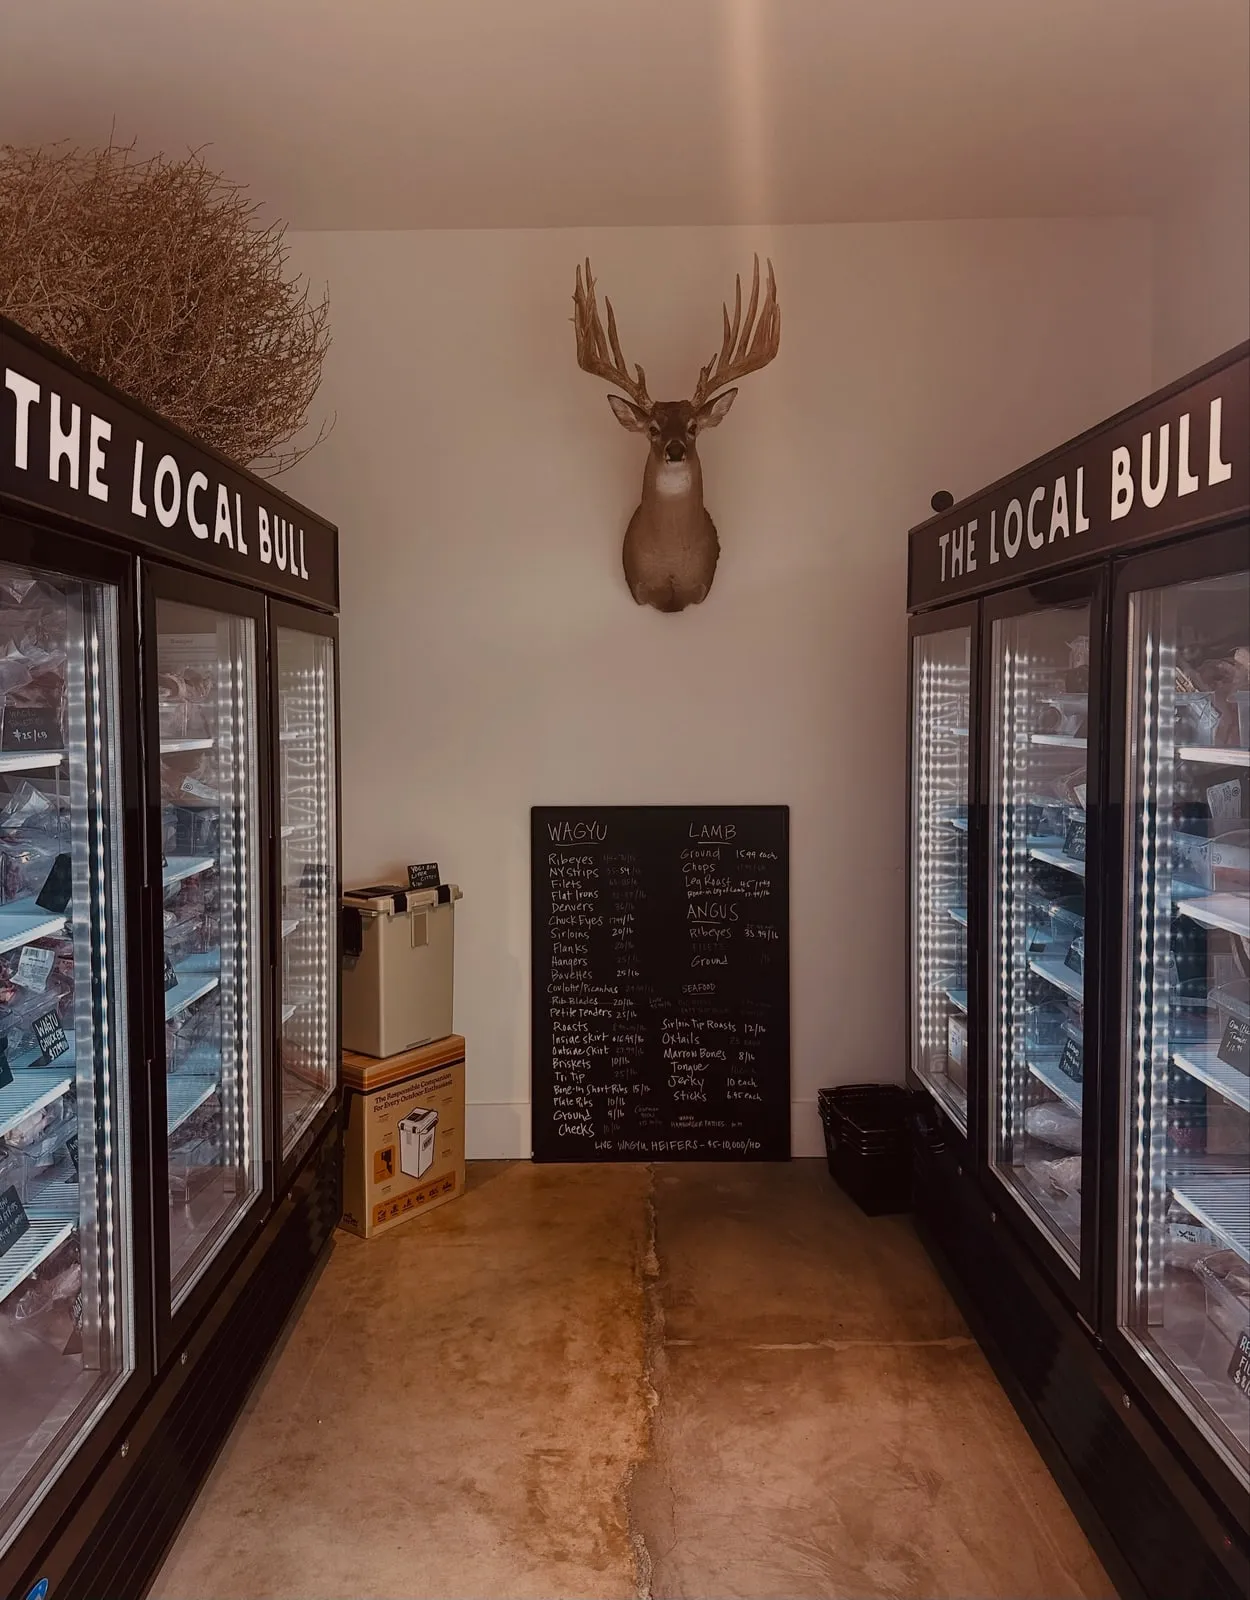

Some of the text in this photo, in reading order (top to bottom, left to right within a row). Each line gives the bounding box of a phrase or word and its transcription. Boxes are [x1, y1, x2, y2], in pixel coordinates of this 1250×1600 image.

[5, 367, 309, 581] THE LOCAL BULL
[938, 396, 1232, 583] THE LOCAL BULL
[547, 820, 608, 841] WAGYU
[688, 821, 737, 840] LAMB
[680, 848, 721, 860] Ground
[548, 852, 593, 870] Ribeyes
[549, 867, 564, 878] NY
[682, 862, 717, 874] Chops
[551, 879, 582, 890] Filets
[685, 875, 702, 890] Leg
[704, 874, 732, 886] Roast
[551, 889, 599, 901] Flat Irons
[552, 902, 594, 914] Denvers
[686, 901, 739, 921] ANGUS
[548, 914, 578, 926] Chuck
[578, 914, 604, 930] Eyes
[550, 928, 590, 940] Sirloins
[689, 925, 732, 942] Ribeyes
[552, 941, 589, 954] Flanks
[551, 956, 588, 974] Hangers
[690, 954, 729, 968] Ground
[681, 982, 717, 994] SEAFOOD
[578, 1007, 612, 1018] Tenders
[34, 1012, 59, 1037] WAGYU
[552, 1020, 589, 1032] Roasts
[661, 1017, 690, 1030] Sirloin
[691, 1018, 705, 1030] Tip
[706, 1020, 737, 1033] Roasts
[552, 1033, 581, 1045] Inside
[661, 1032, 701, 1045] Oxtails
[586, 1044, 611, 1057] Skirt
[663, 1048, 698, 1060] Marrow
[700, 1048, 728, 1061] Bones
[552, 1058, 592, 1071] Briskets
[670, 1061, 710, 1077] Tongue
[554, 1071, 568, 1082] Tri
[374, 1072, 452, 1104] The Responsible Companion
[586, 1084, 609, 1096] Short
[610, 1084, 628, 1095] Ribs
[668, 1075, 758, 1093] Jerky 10 each
[373, 1080, 453, 1112] For Every Outdoor Enthusiast
[575, 1096, 594, 1108] Ribs
[673, 1090, 708, 1102] Sticks
[552, 1108, 593, 1122] Ground
[558, 1122, 596, 1138] Cheeks
[594, 1140, 613, 1150] LIVE
[618, 1140, 648, 1152] WAGYU
[651, 1140, 698, 1152] HEIFERS
